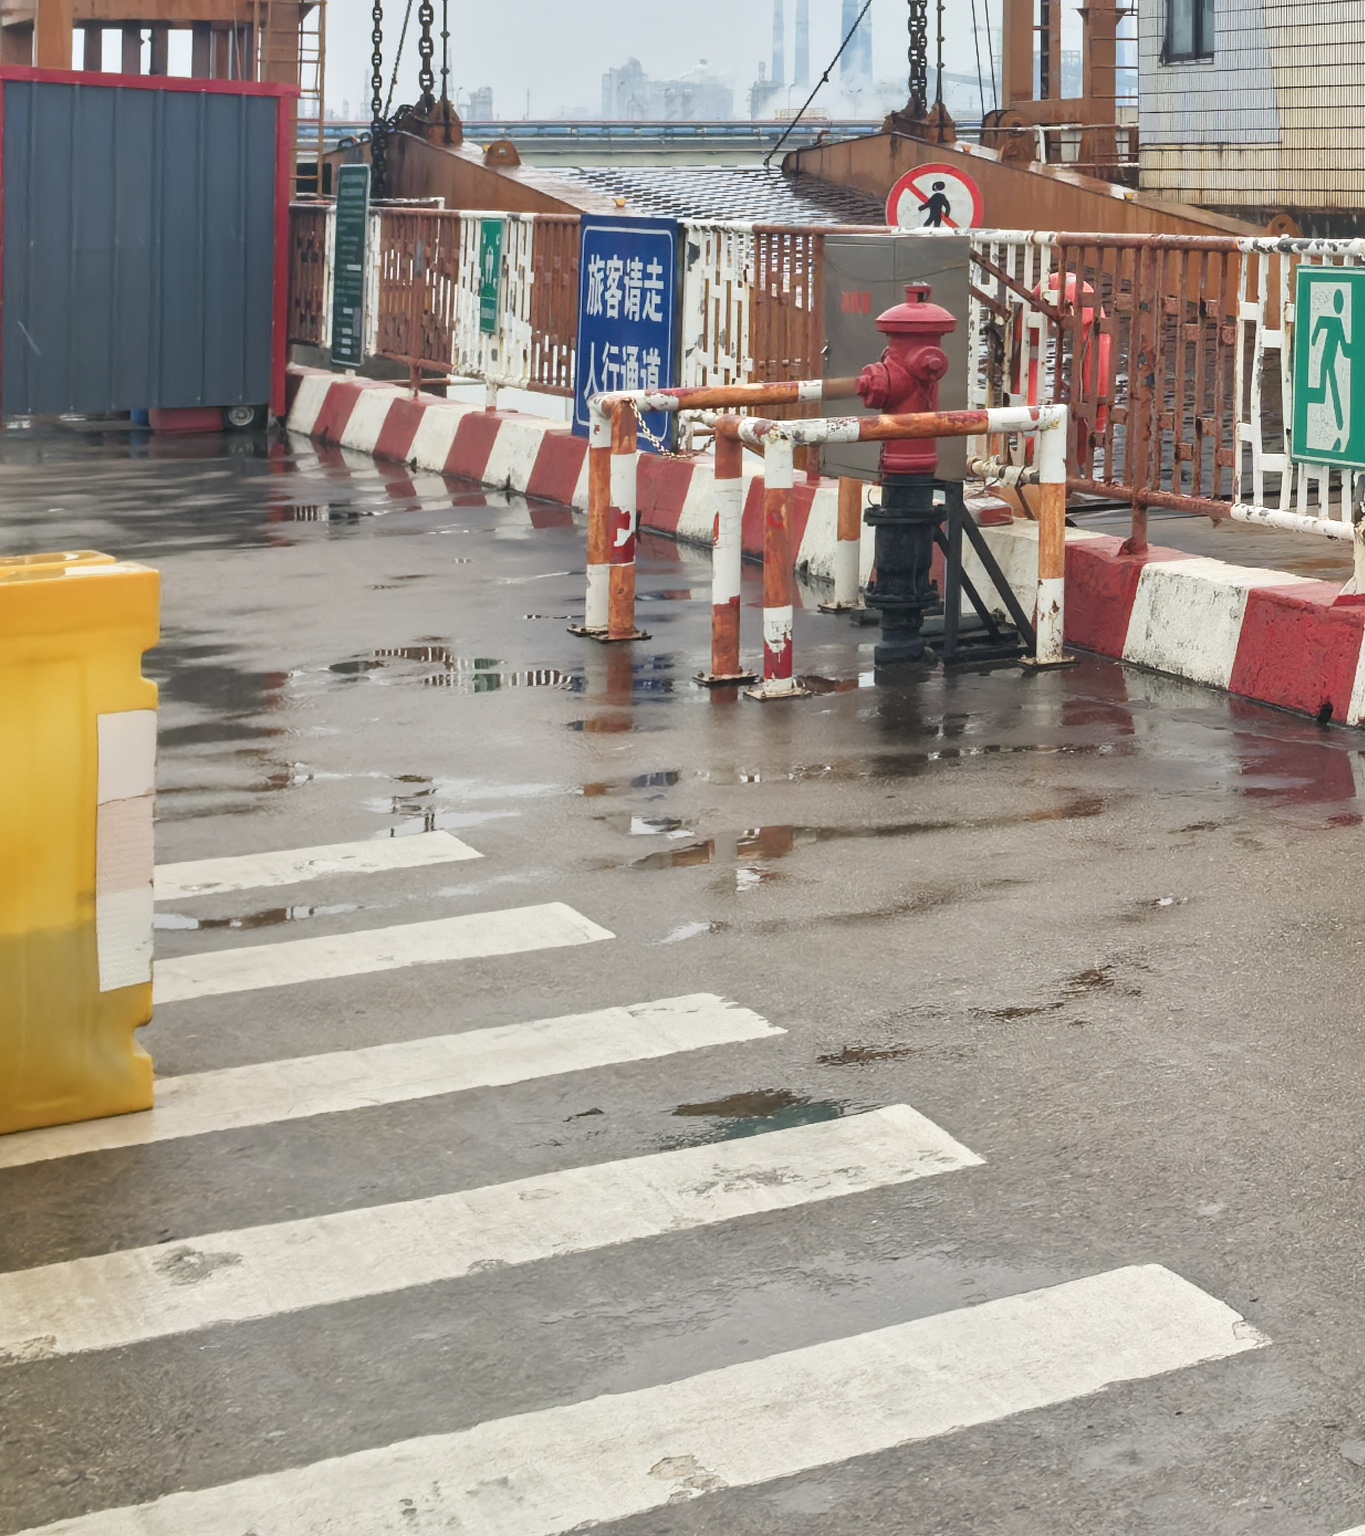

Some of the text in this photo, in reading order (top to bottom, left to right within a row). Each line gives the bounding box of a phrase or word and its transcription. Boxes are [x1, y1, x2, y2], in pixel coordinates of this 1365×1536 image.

[586, 253, 664, 323] 旅客请走
[583, 340, 661, 400] 人行通道
